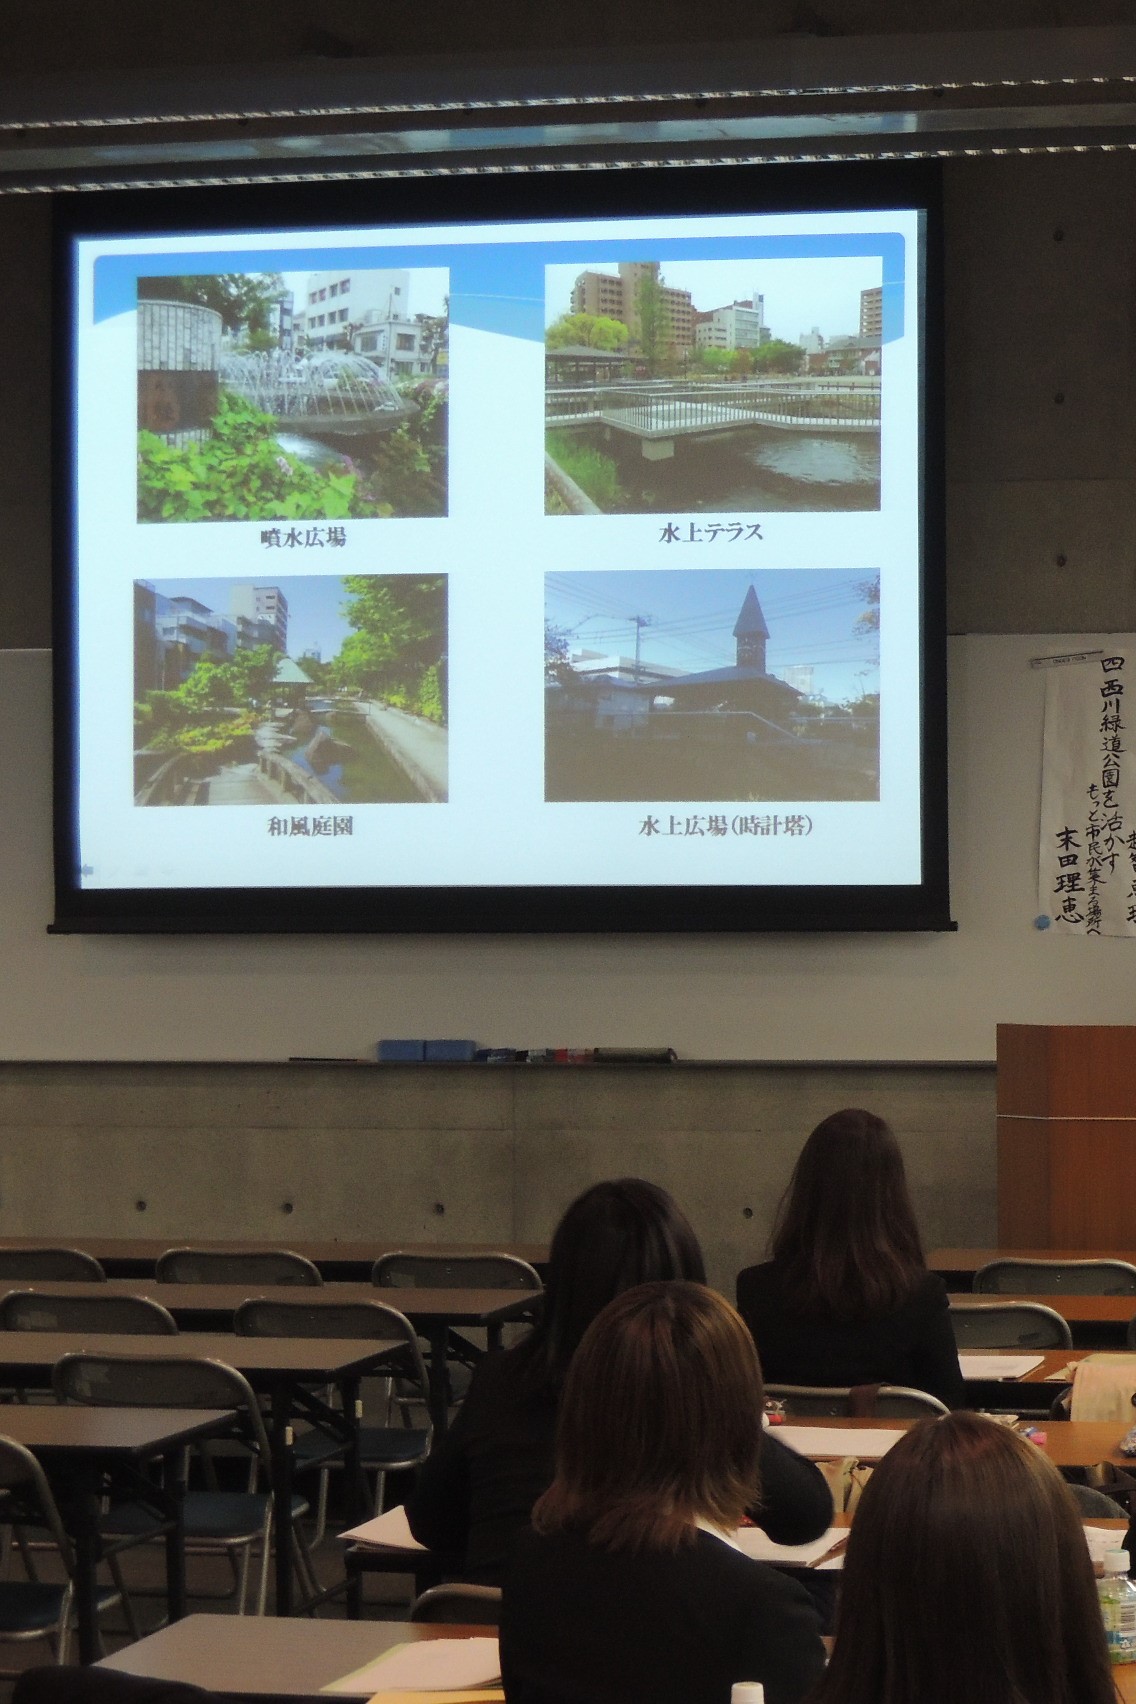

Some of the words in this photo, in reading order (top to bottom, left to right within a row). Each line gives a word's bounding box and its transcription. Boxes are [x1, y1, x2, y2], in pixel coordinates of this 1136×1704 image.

[260, 526, 348, 549] 噴水広場
[658, 522, 765, 544] 水上テラス
[267, 815, 354, 838] 和風庭園
[1053, 825, 1086, 924] 末田理恵
